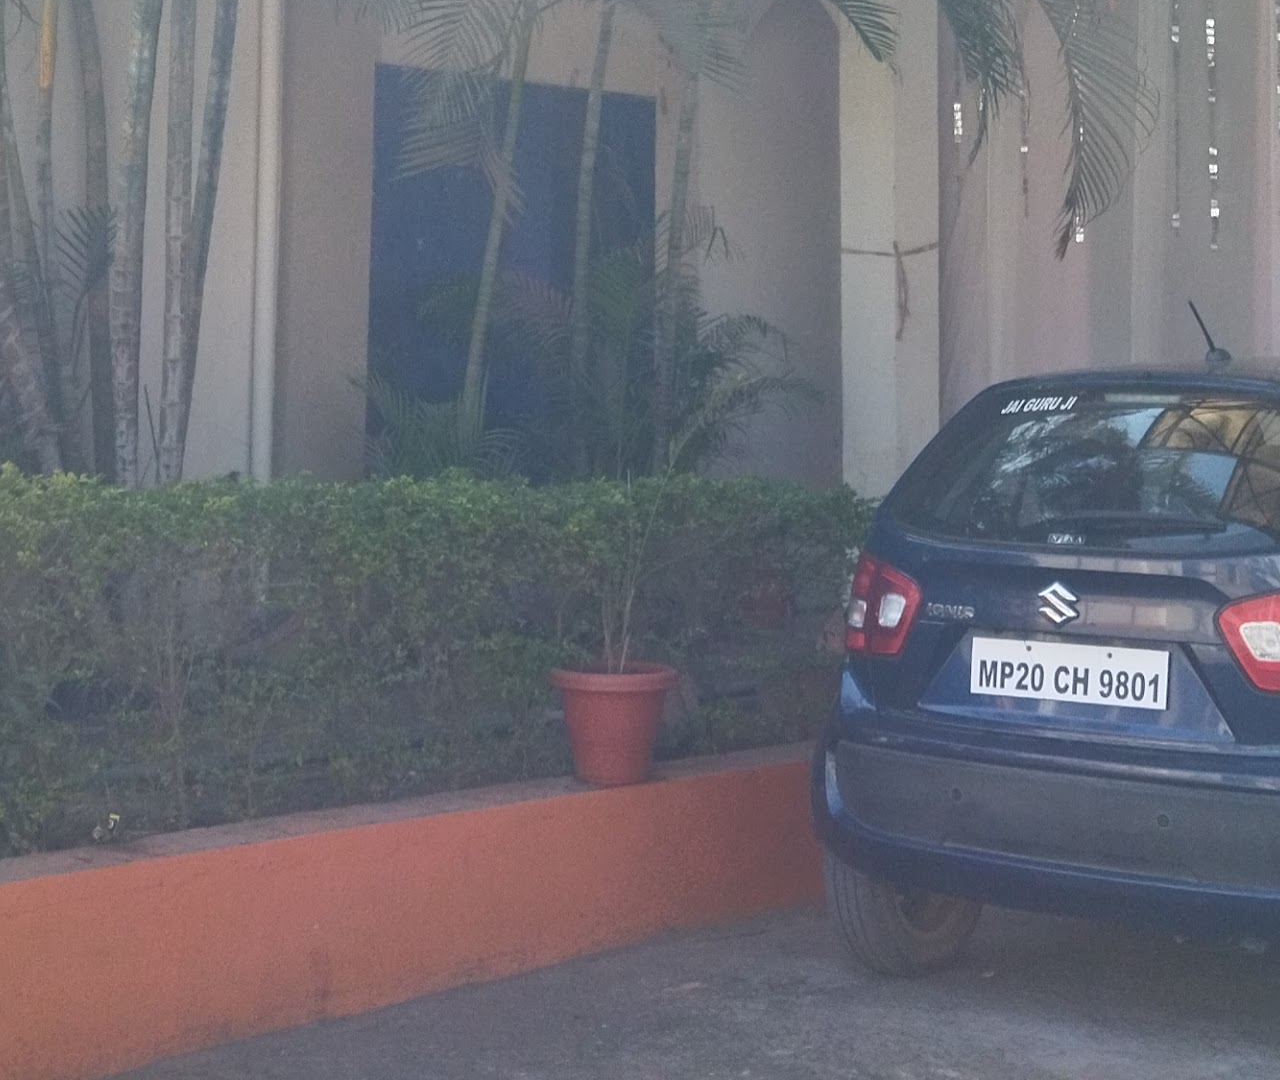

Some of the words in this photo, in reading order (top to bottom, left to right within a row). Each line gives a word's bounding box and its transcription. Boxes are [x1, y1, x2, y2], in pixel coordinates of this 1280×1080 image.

[1001, 399, 1025, 414] JAI
[1023, 396, 1063, 412] GURU
[1060, 396, 1078, 410] JI
[978, 660, 1045, 692] MP20
[1053, 665, 1090, 696] CH
[1099, 669, 1160, 703] 9801
